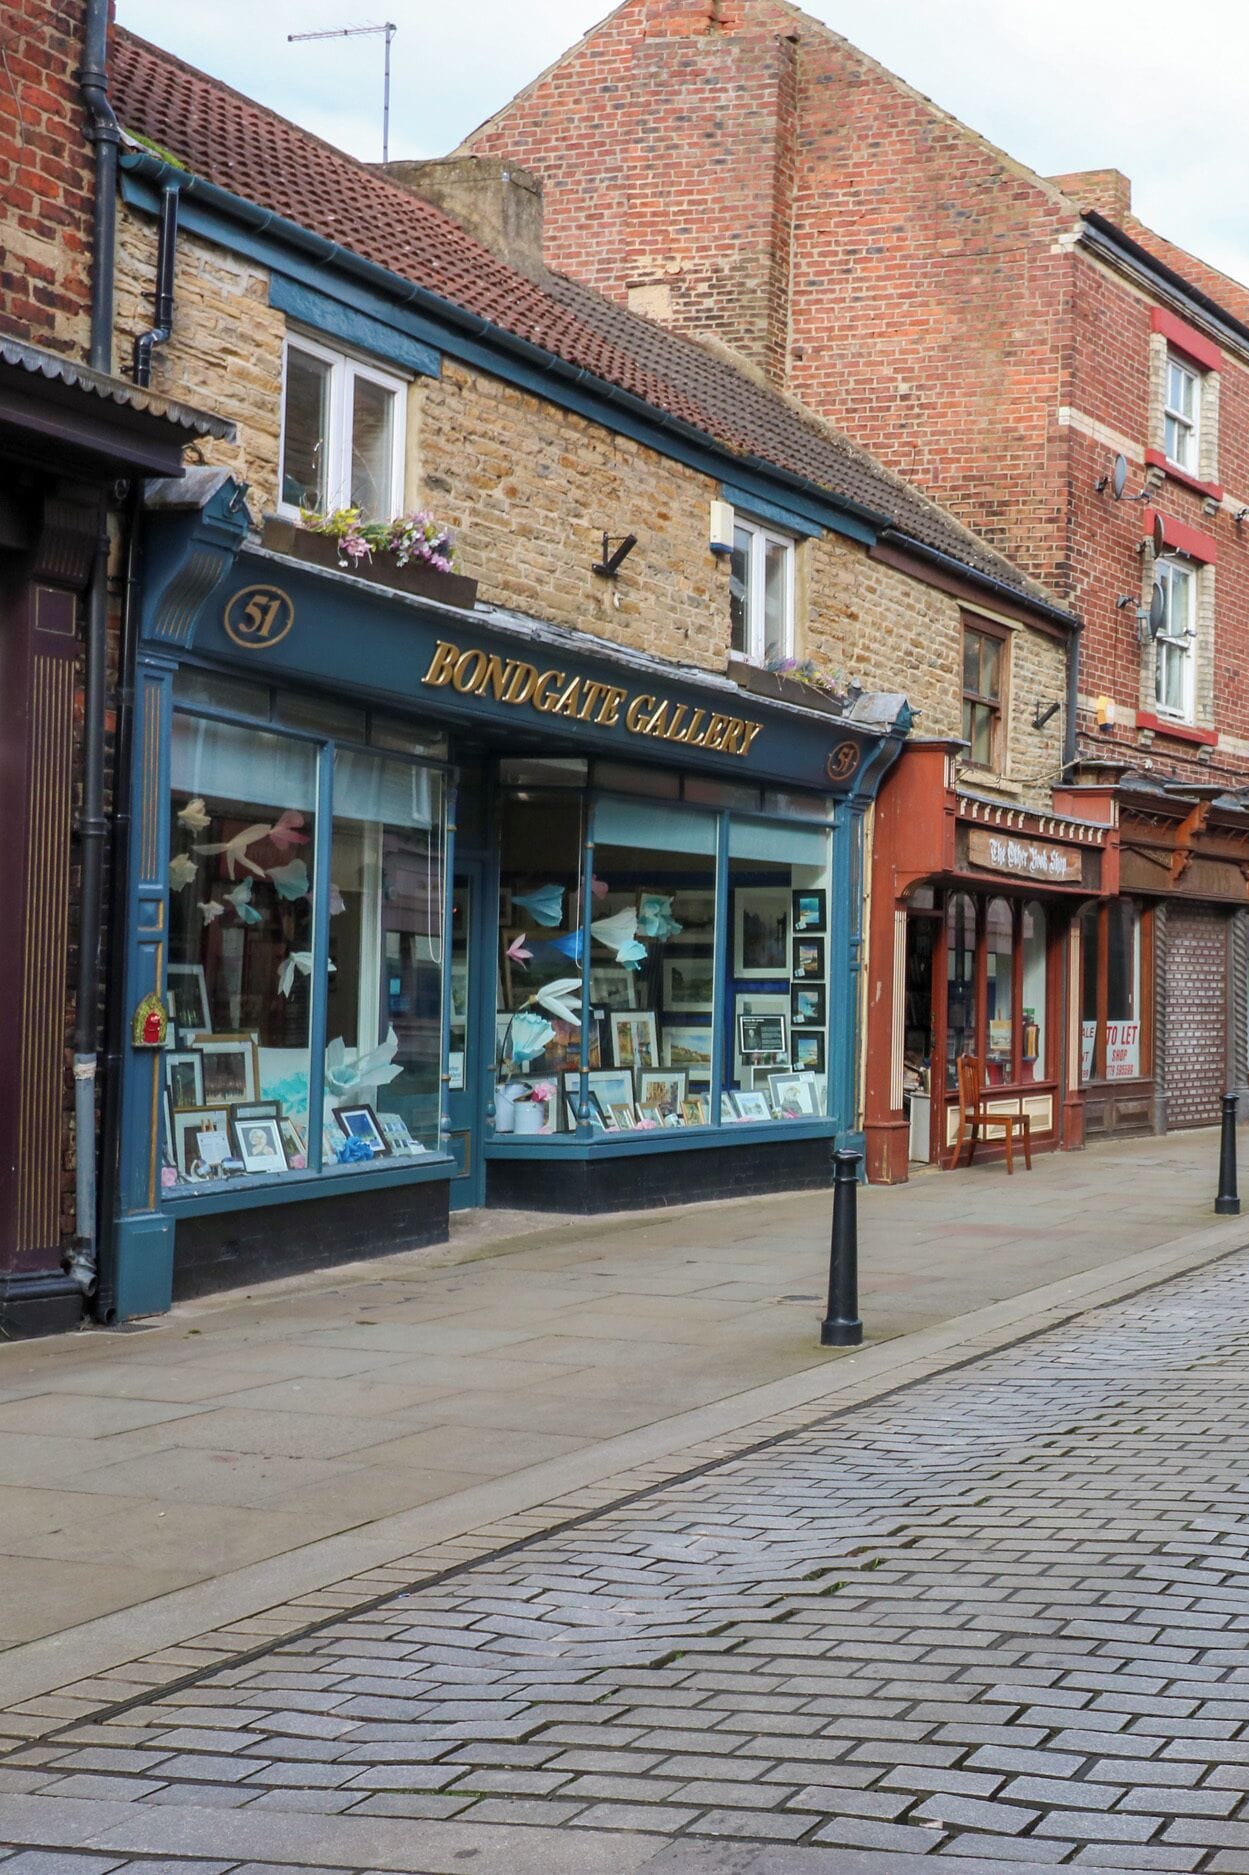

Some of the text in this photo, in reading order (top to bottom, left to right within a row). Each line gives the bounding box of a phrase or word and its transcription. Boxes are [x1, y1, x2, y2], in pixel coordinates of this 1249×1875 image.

[238, 595, 281, 637] 51
[420, 639, 764, 756] BONDGATE GALLERY
[833, 747, 855, 772] 51
[989, 838, 1006, 866] The
[1048, 849, 1067, 880] Shop
[1106, 1025, 1138, 1046] TO LET
